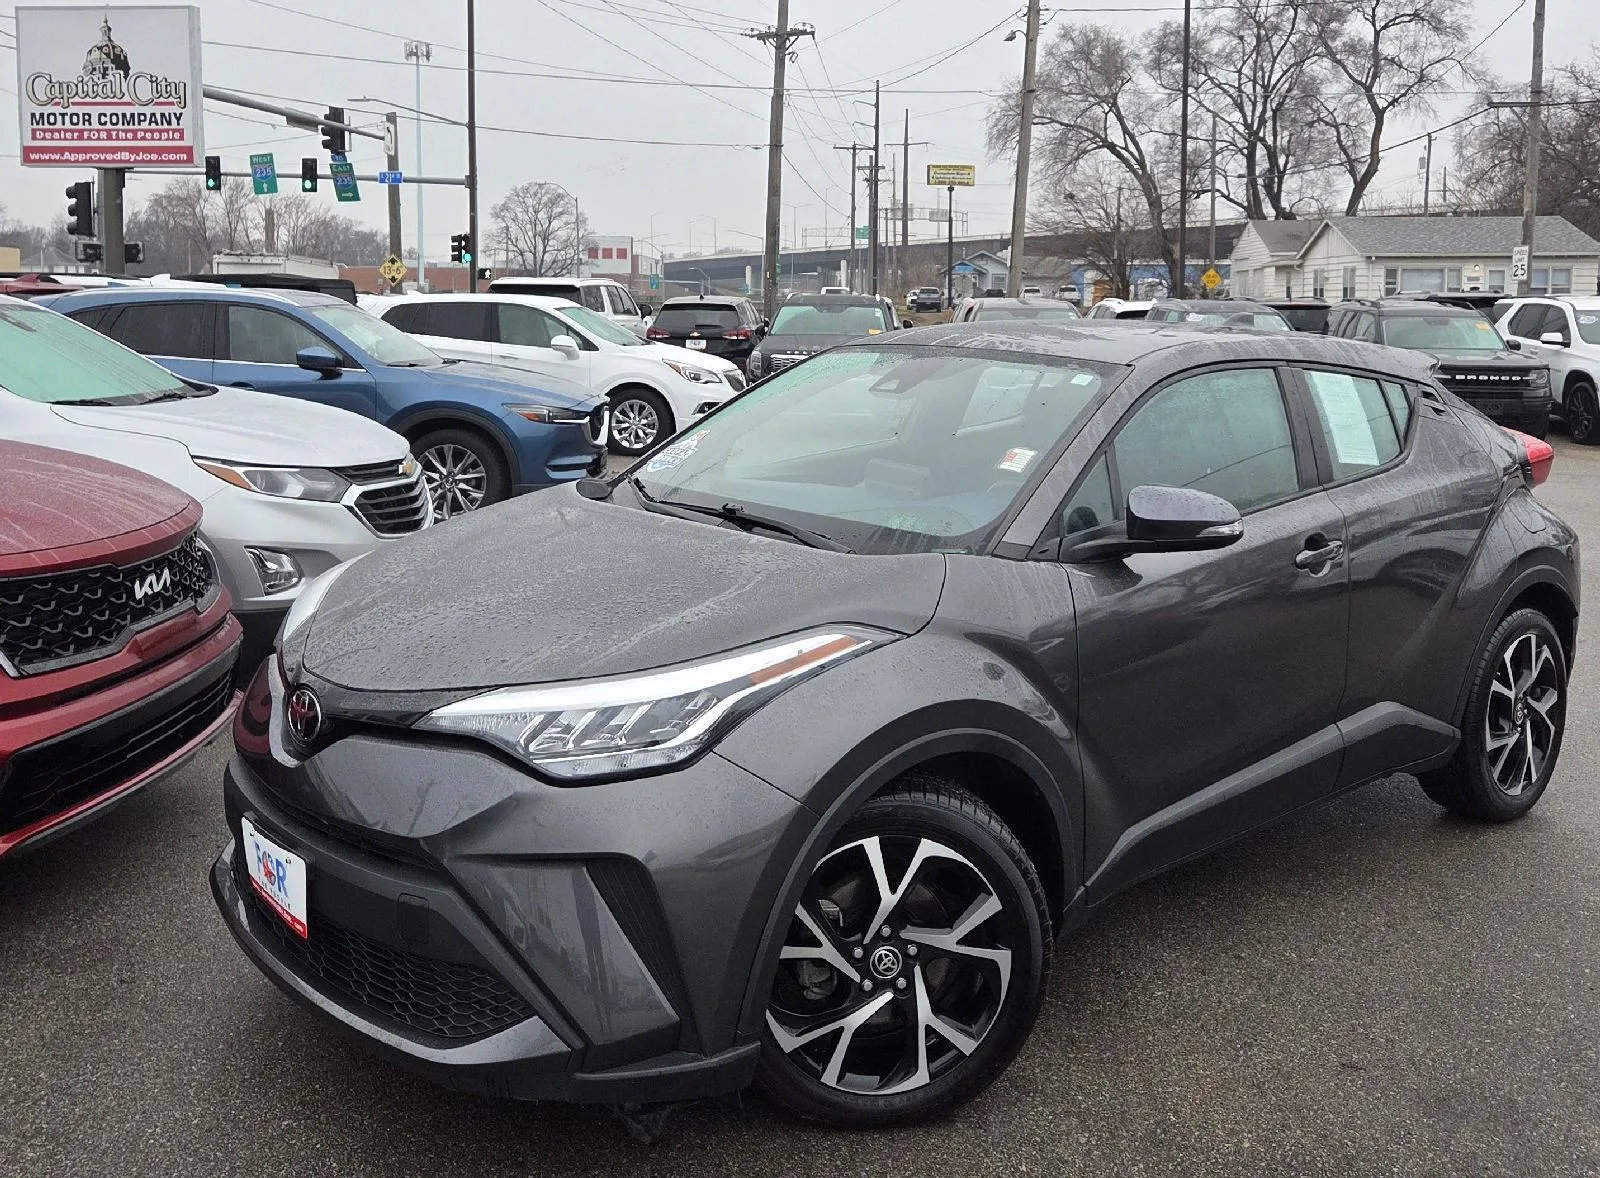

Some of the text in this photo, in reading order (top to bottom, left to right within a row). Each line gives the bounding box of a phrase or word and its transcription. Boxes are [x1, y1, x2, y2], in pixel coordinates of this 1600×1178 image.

[26, 72, 186, 109] Capital City
[30, 112, 184, 126] MOTOR COMPANY
[36, 130, 180, 140] Dealer FOR The People
[29, 151, 187, 162] www.ApprovedByJoe.com
[255, 168, 272, 177] 235
[336, 176, 353, 185] 235
[1513, 264, 1526, 277] 25
